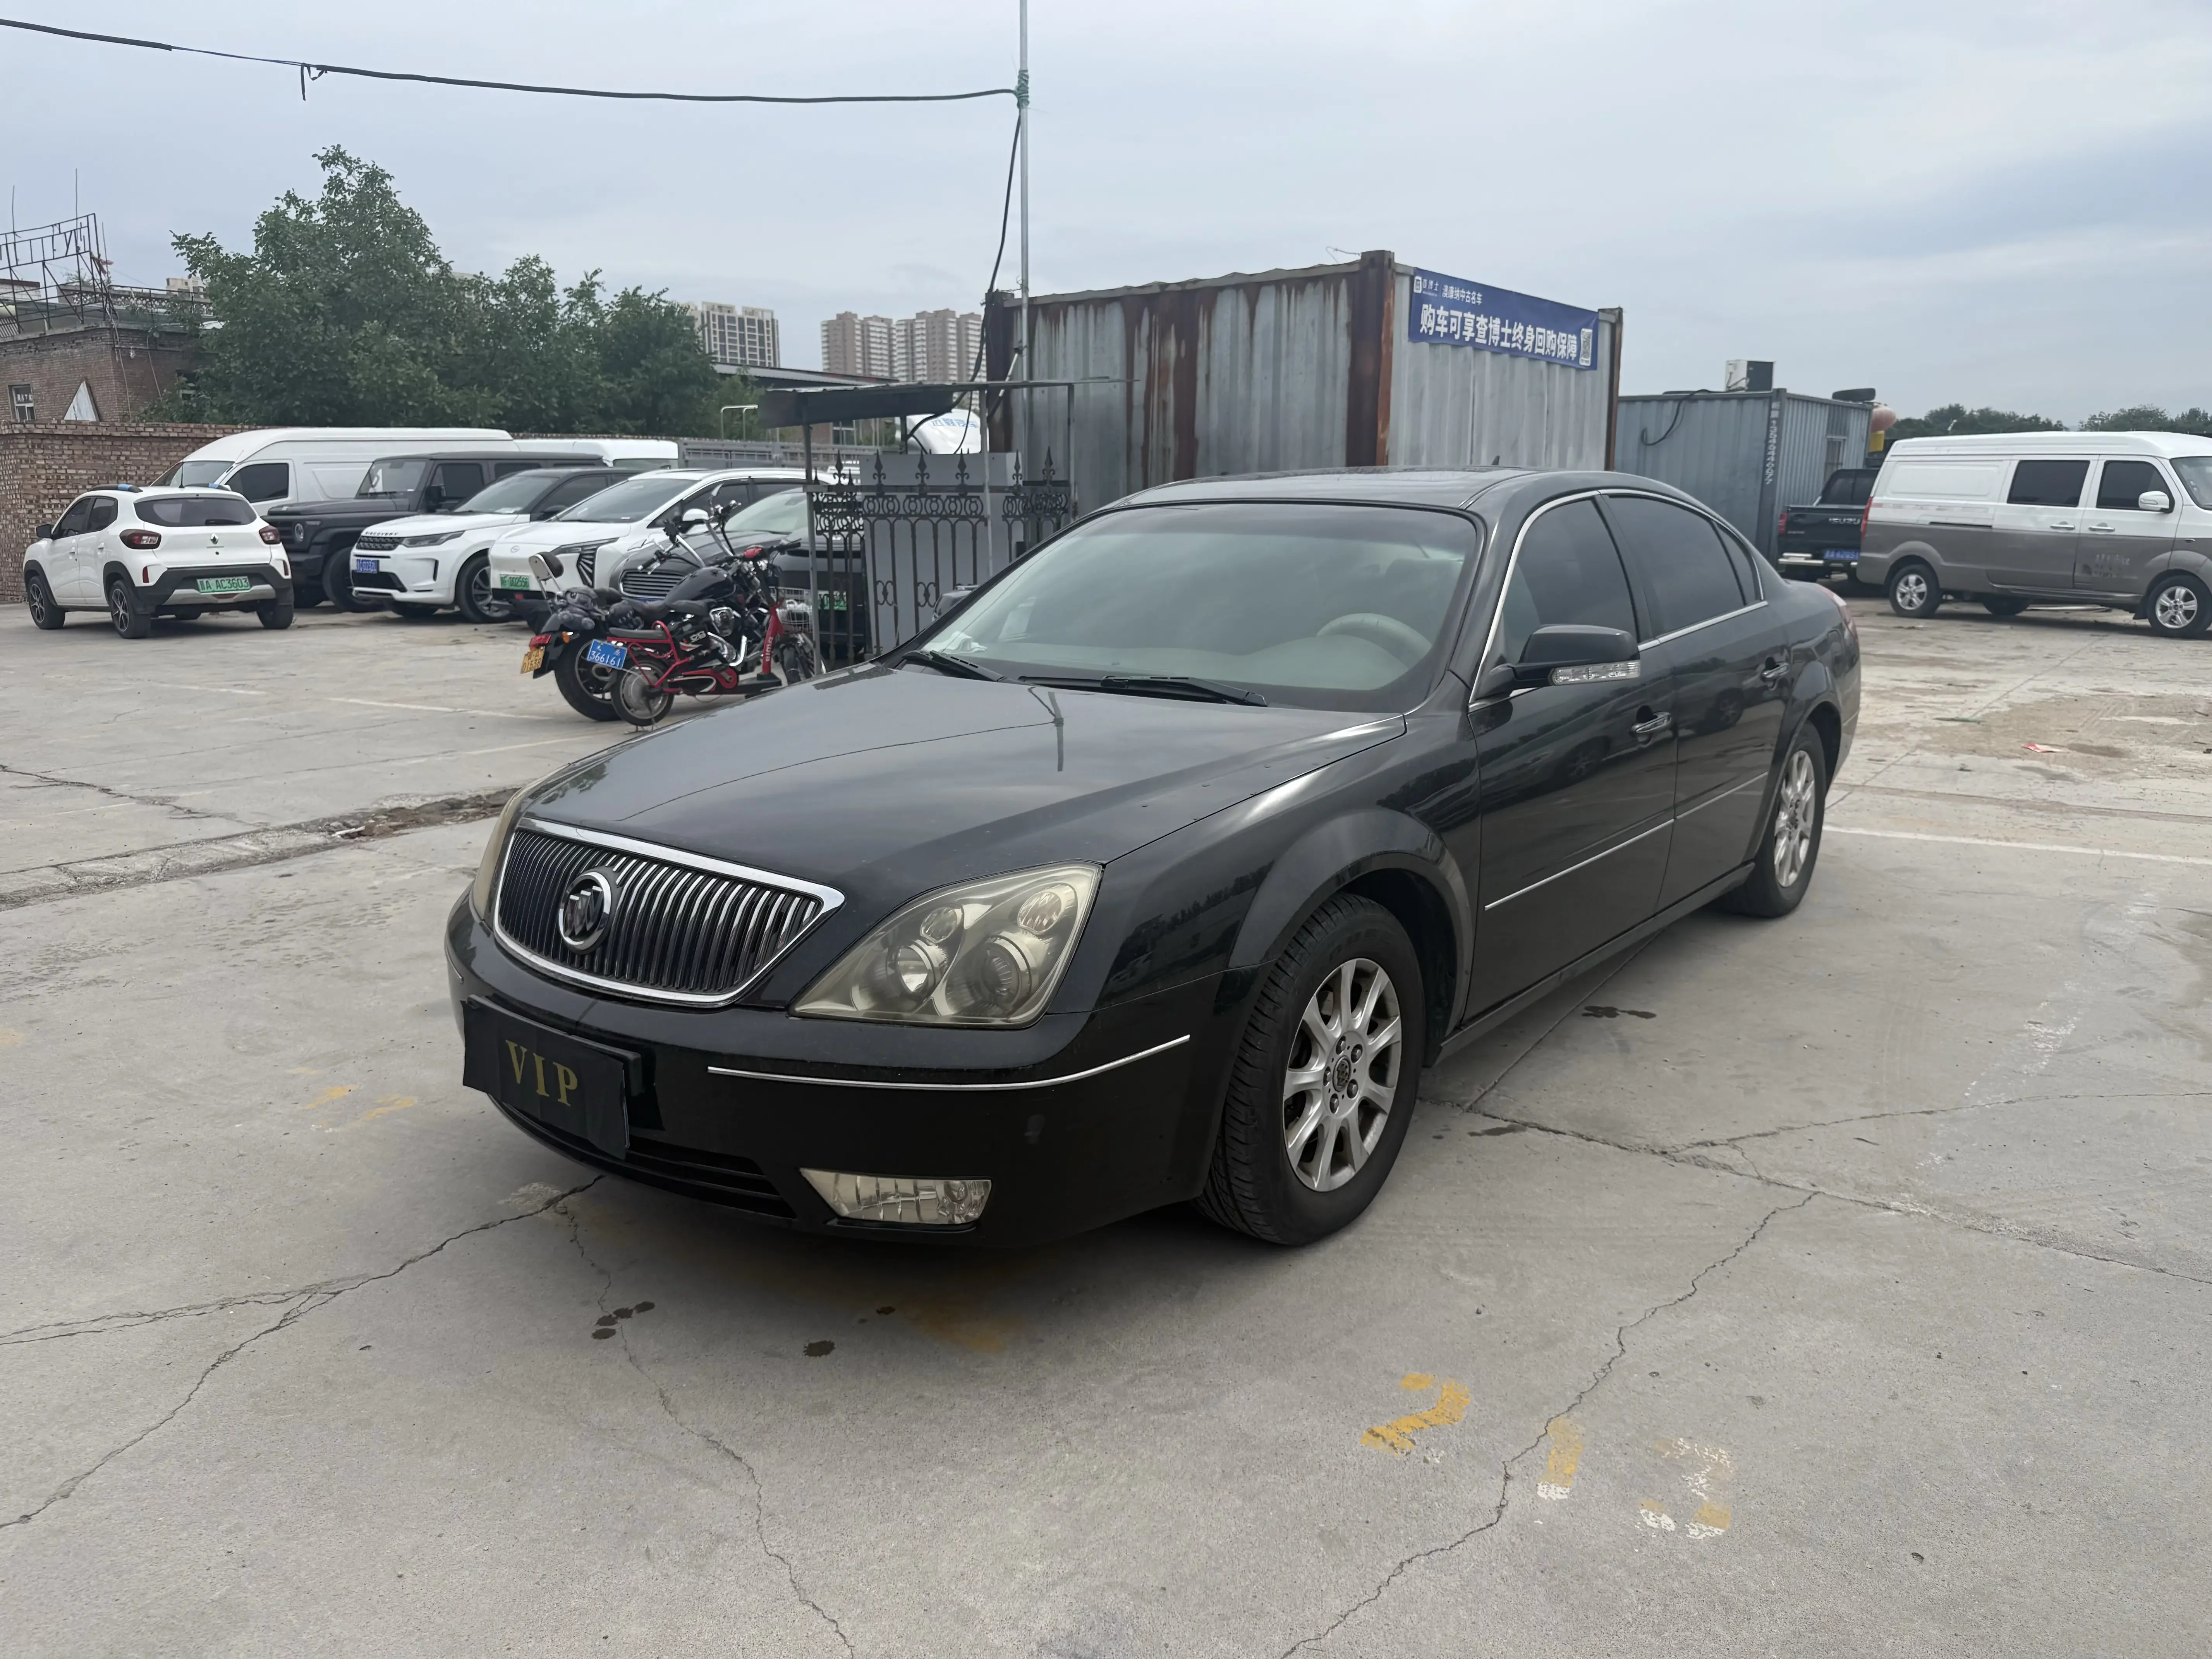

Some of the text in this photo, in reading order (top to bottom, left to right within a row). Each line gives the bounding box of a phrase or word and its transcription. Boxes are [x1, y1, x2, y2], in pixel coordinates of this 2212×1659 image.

[1420, 304, 1577, 361] 购车可享查博士终身回购保障
[215, 578, 249, 589] AC3603
[522, 658, 541, 672] 01538
[589, 650, 621, 667] 366161
[505, 1039, 578, 1107] VIP
